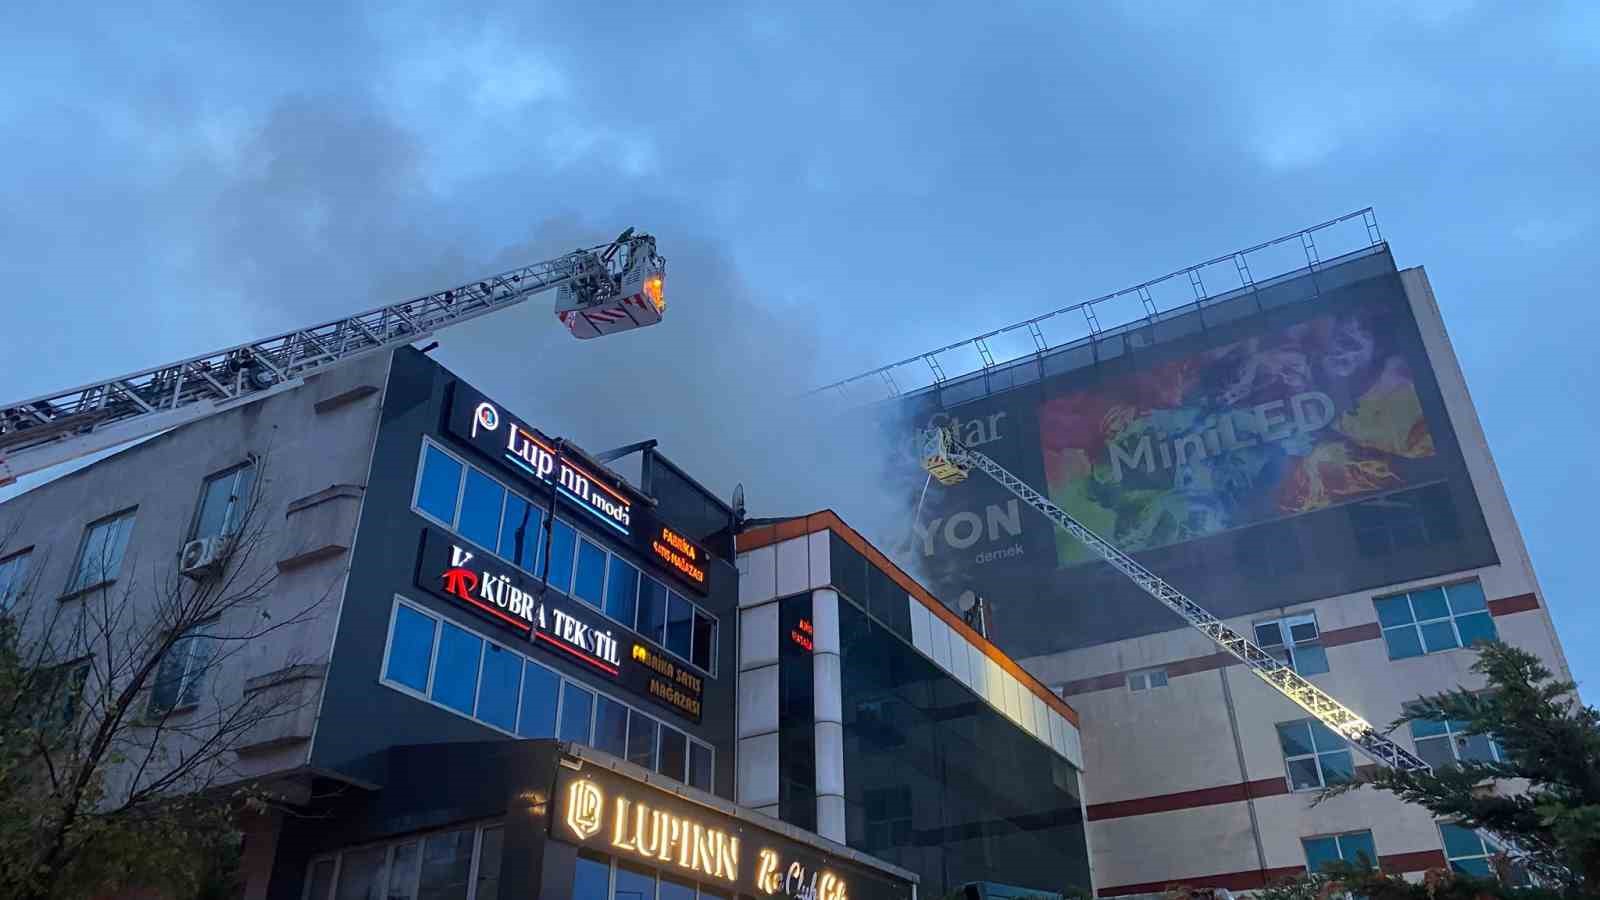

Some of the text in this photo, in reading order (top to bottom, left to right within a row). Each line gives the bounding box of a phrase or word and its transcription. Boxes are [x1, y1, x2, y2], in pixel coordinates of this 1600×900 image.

[506, 423, 590, 500] Lupnn
[1108, 391, 1335, 482] MiniLED
[480, 571, 620, 666] KÜBRA TEKSTİL
[612, 796, 739, 881] LUPINN
